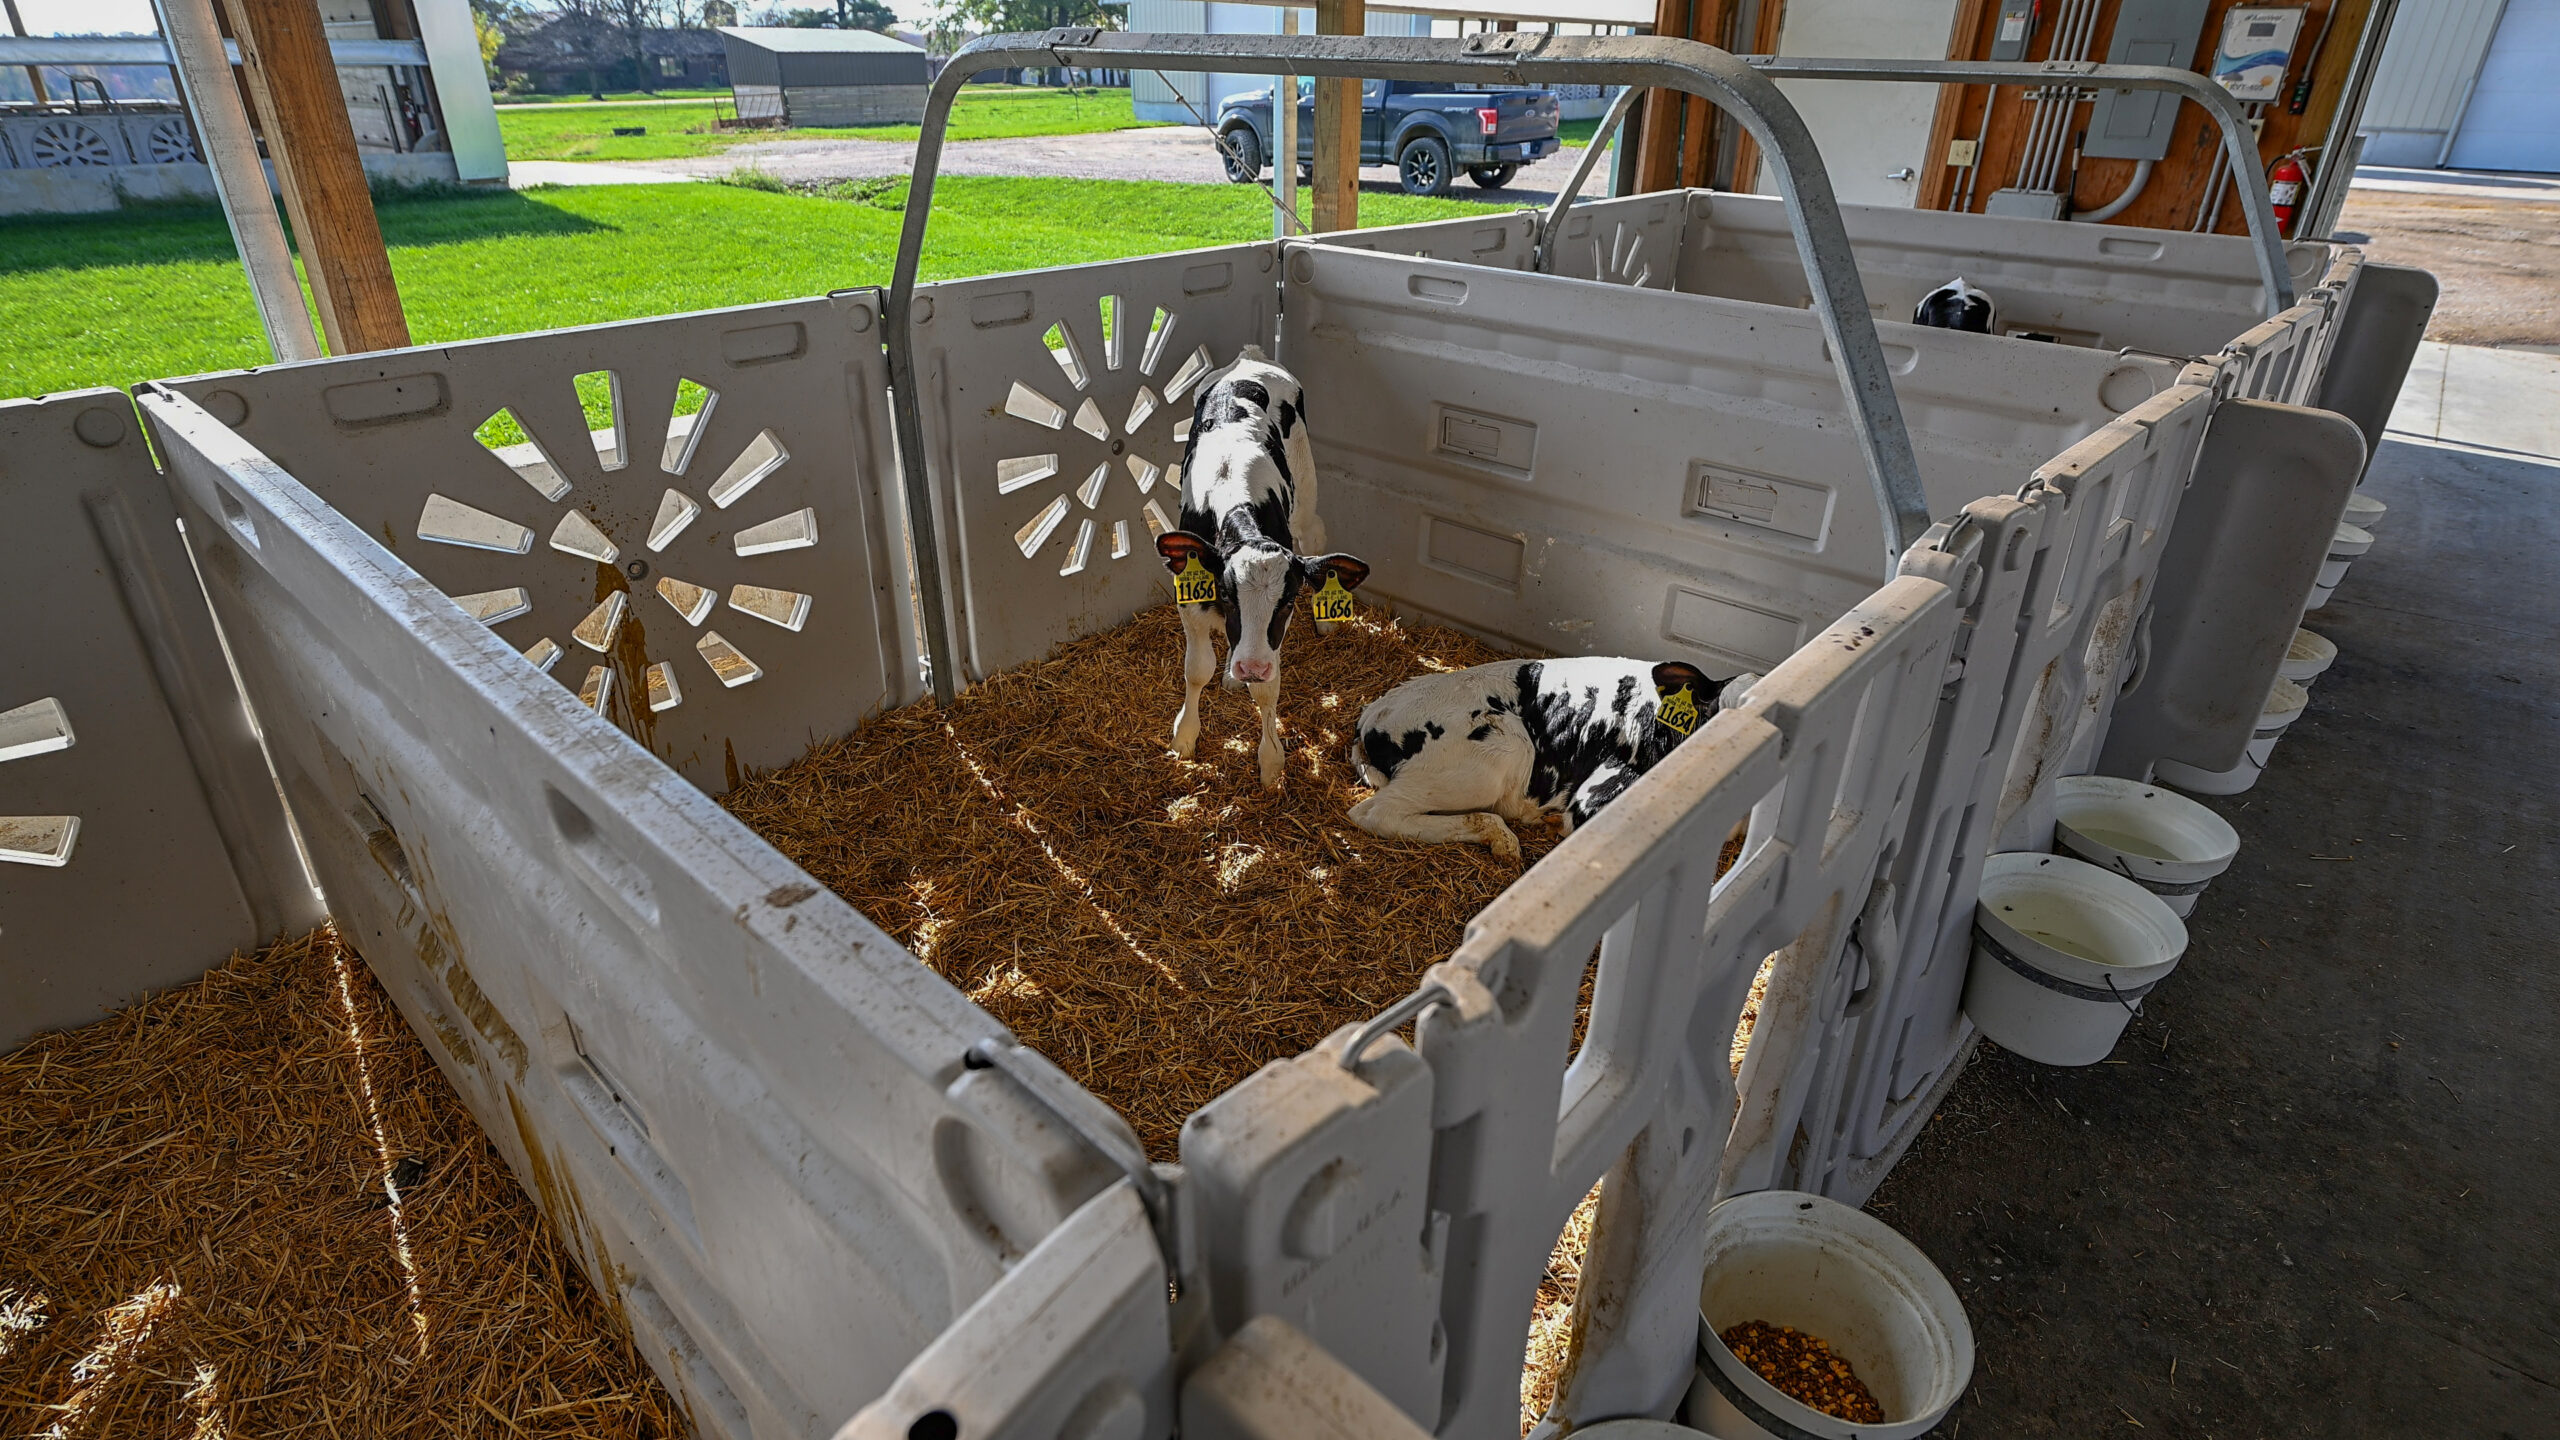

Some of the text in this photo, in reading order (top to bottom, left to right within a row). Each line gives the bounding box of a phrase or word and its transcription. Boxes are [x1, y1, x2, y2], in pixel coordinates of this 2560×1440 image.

[1179, 580, 1214, 601] 11656
[1316, 600, 1351, 619] 11656
[1657, 703, 1694, 732] 11654
